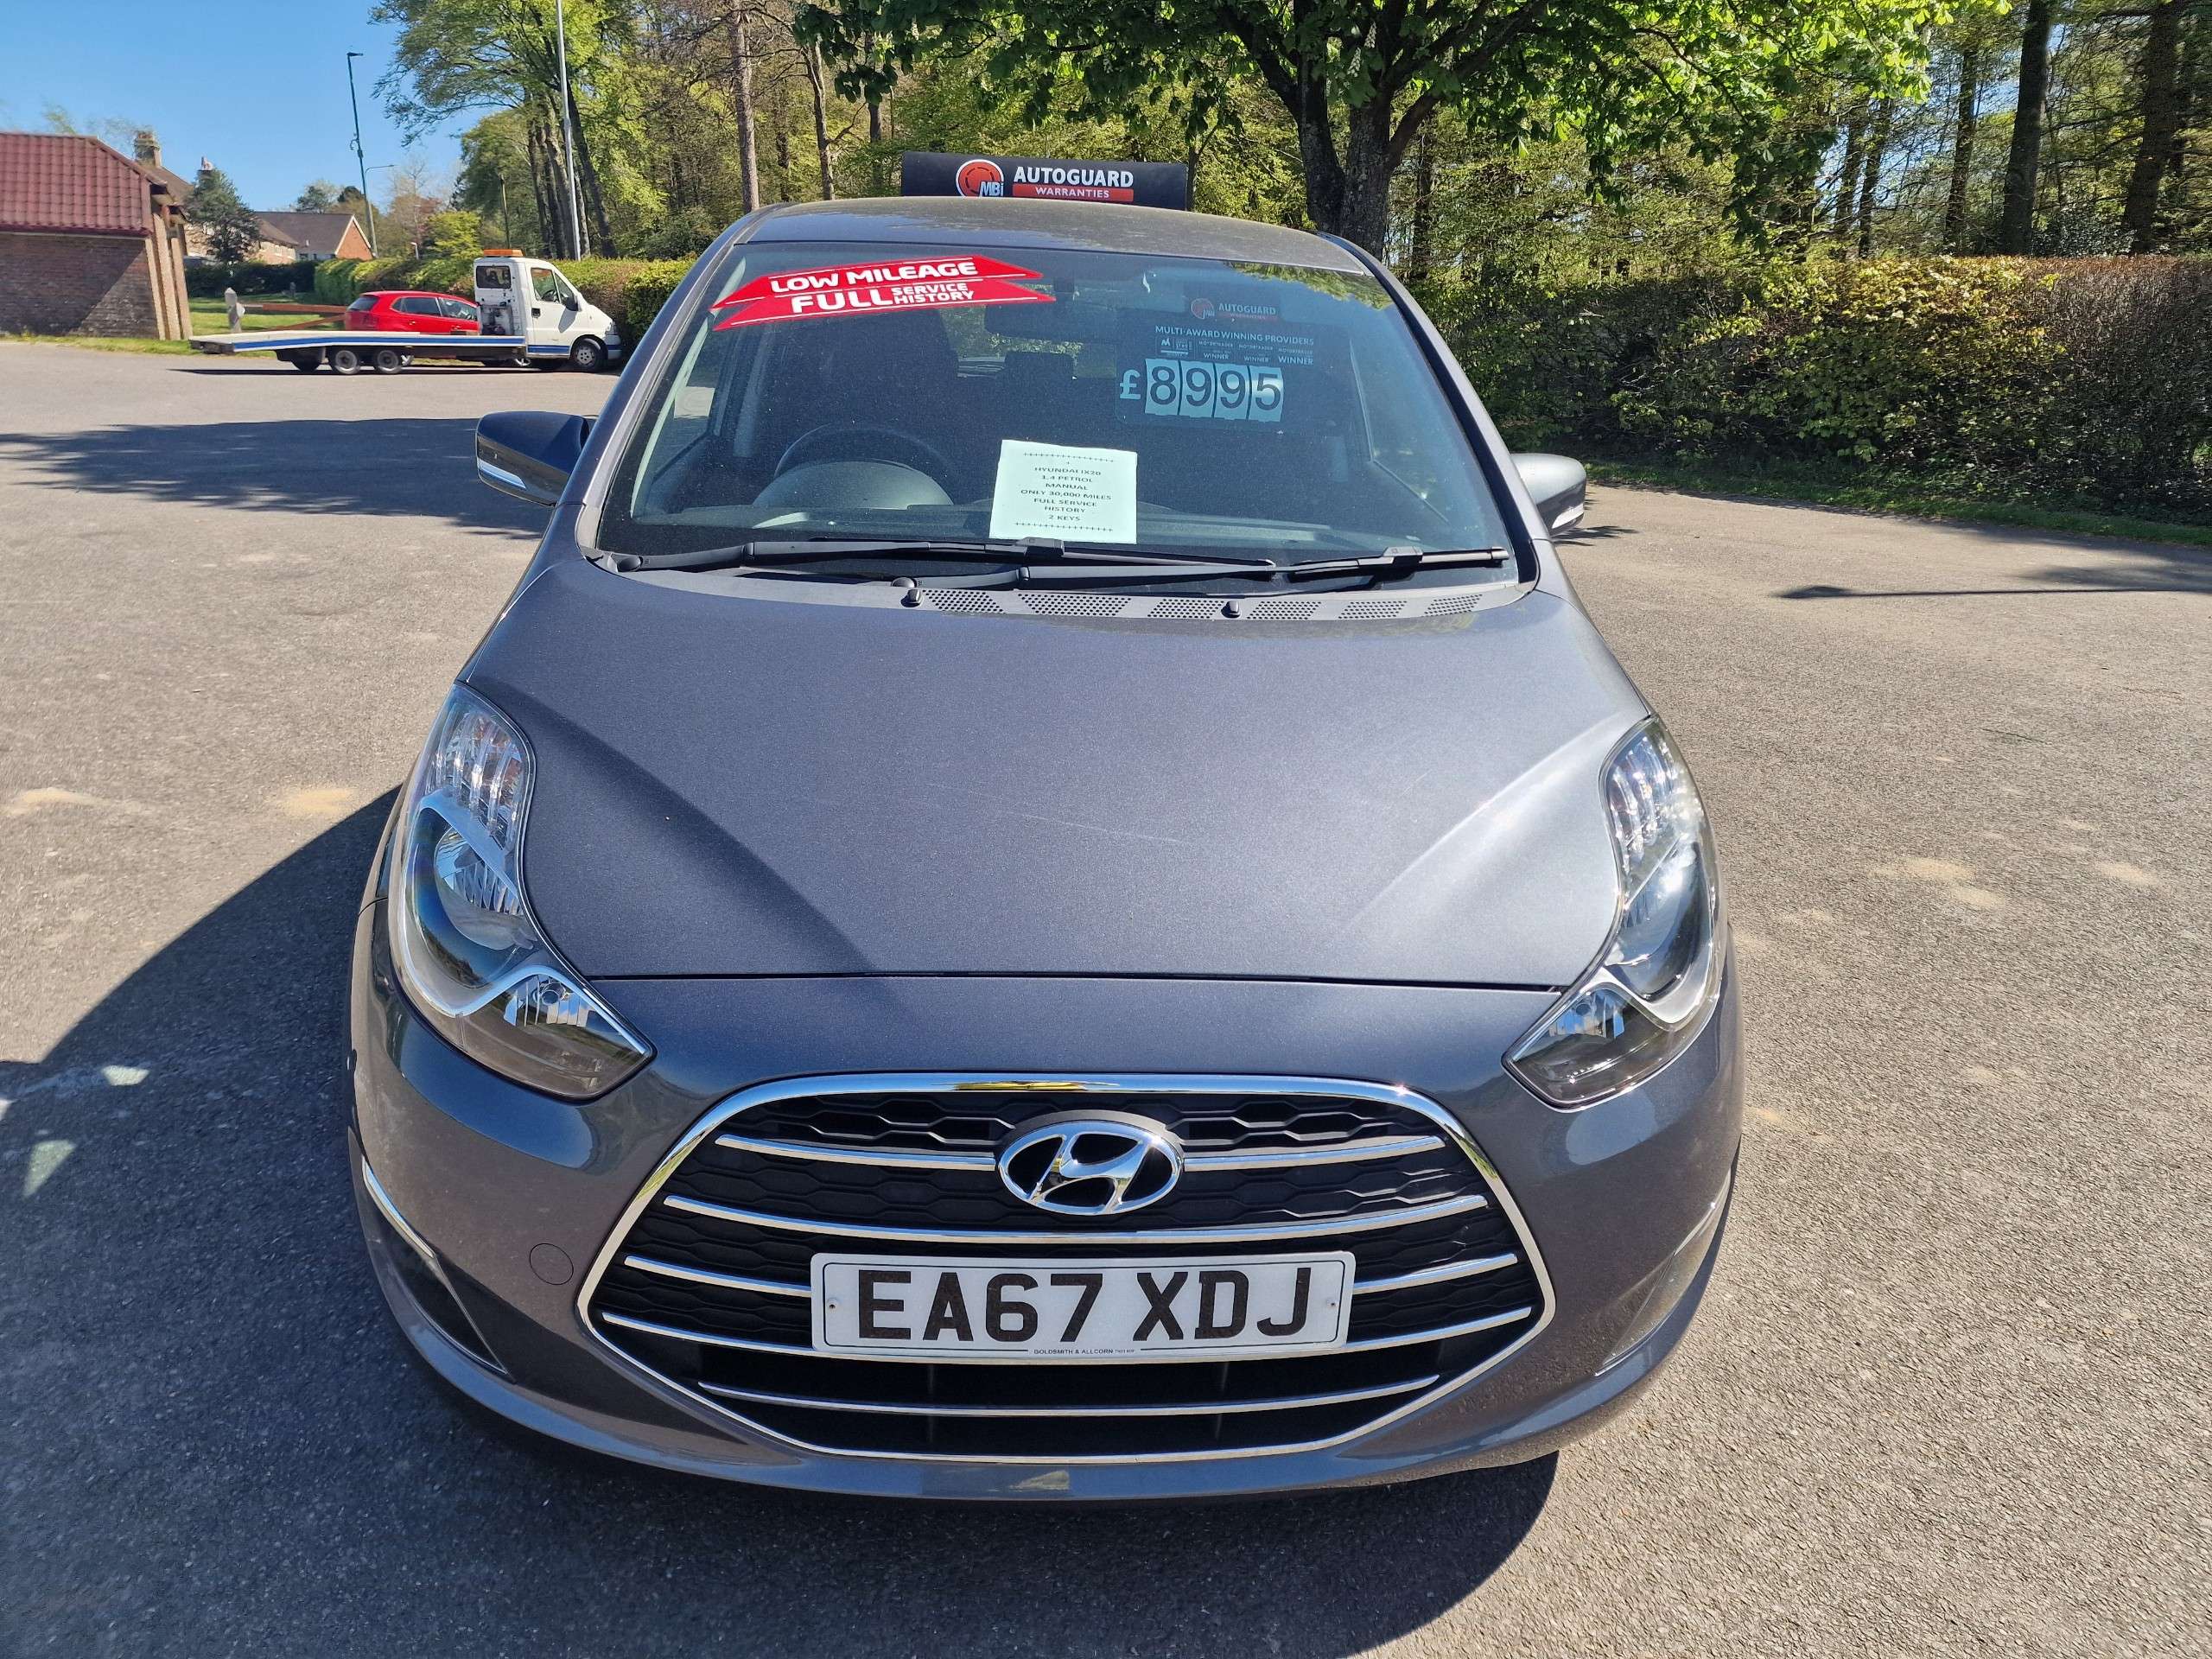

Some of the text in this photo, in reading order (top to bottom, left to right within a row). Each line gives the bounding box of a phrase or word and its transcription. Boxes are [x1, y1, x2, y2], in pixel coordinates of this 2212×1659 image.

[1014, 166, 1134, 188] AUTOGUARD
[979, 181, 1004, 197] MBi
[1035, 187, 1109, 199] WARRANTIES
[771, 262, 979, 293] LOW MILEAGE
[891, 283, 969, 296] SERVICE
[791, 289, 893, 314] FULL
[893, 290, 975, 305] HISTORY
[1218, 302, 1276, 315] AUTOGUARD
[1221, 331, 1263, 341] WINNING
[1265, 334, 1314, 346] PROVIDERS
[1279, 355, 1314, 365] WINNER
[858, 1267, 1313, 1343] EA67 XDJ
